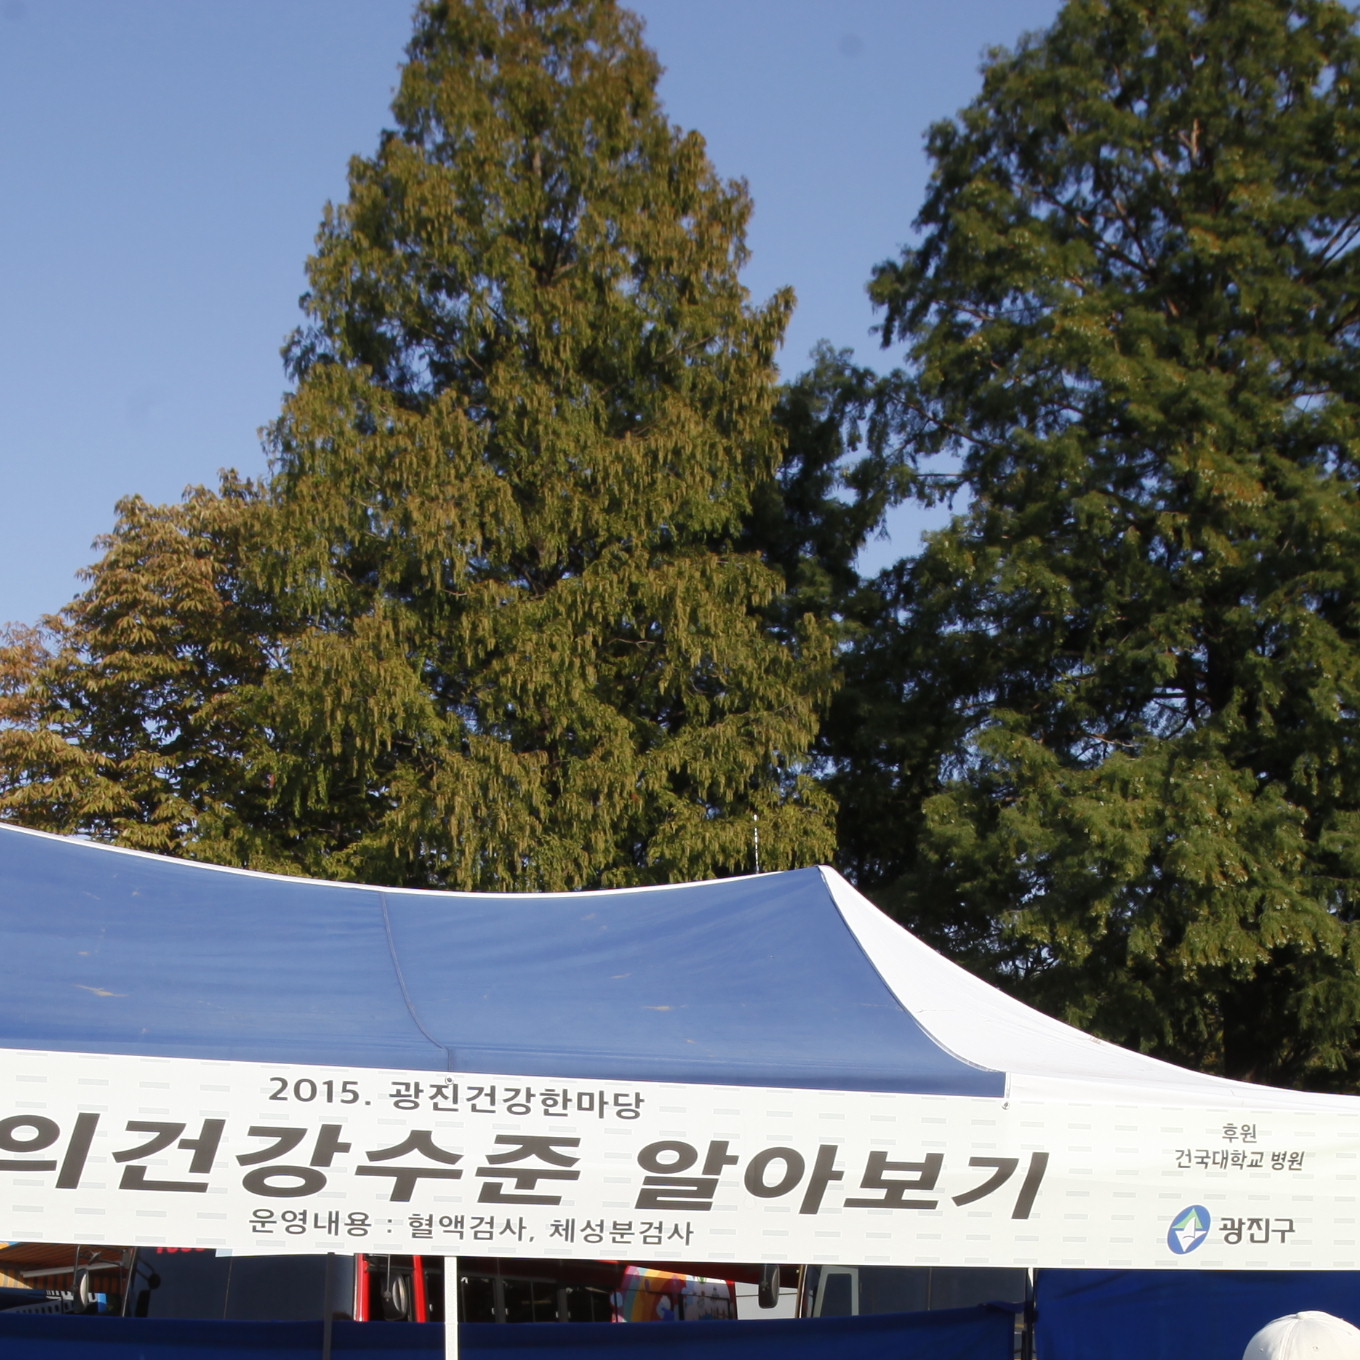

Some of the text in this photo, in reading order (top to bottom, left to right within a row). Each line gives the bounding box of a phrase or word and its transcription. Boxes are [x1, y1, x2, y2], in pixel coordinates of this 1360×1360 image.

[268, 1076, 645, 1121] 2015. 광진건강한마당
[1222, 1123, 1258, 1144] 후원
[1175, 1149, 1305, 1172] 건국대학교 병원
[635, 1139, 1049, 1220] 알아보기
[248, 1208, 373, 1238] 운영내용
[407, 1213, 537, 1244] 혈액검사,
[549, 1218, 695, 1247] 체성분검사
[1219, 1217, 1297, 1245] 광진구
